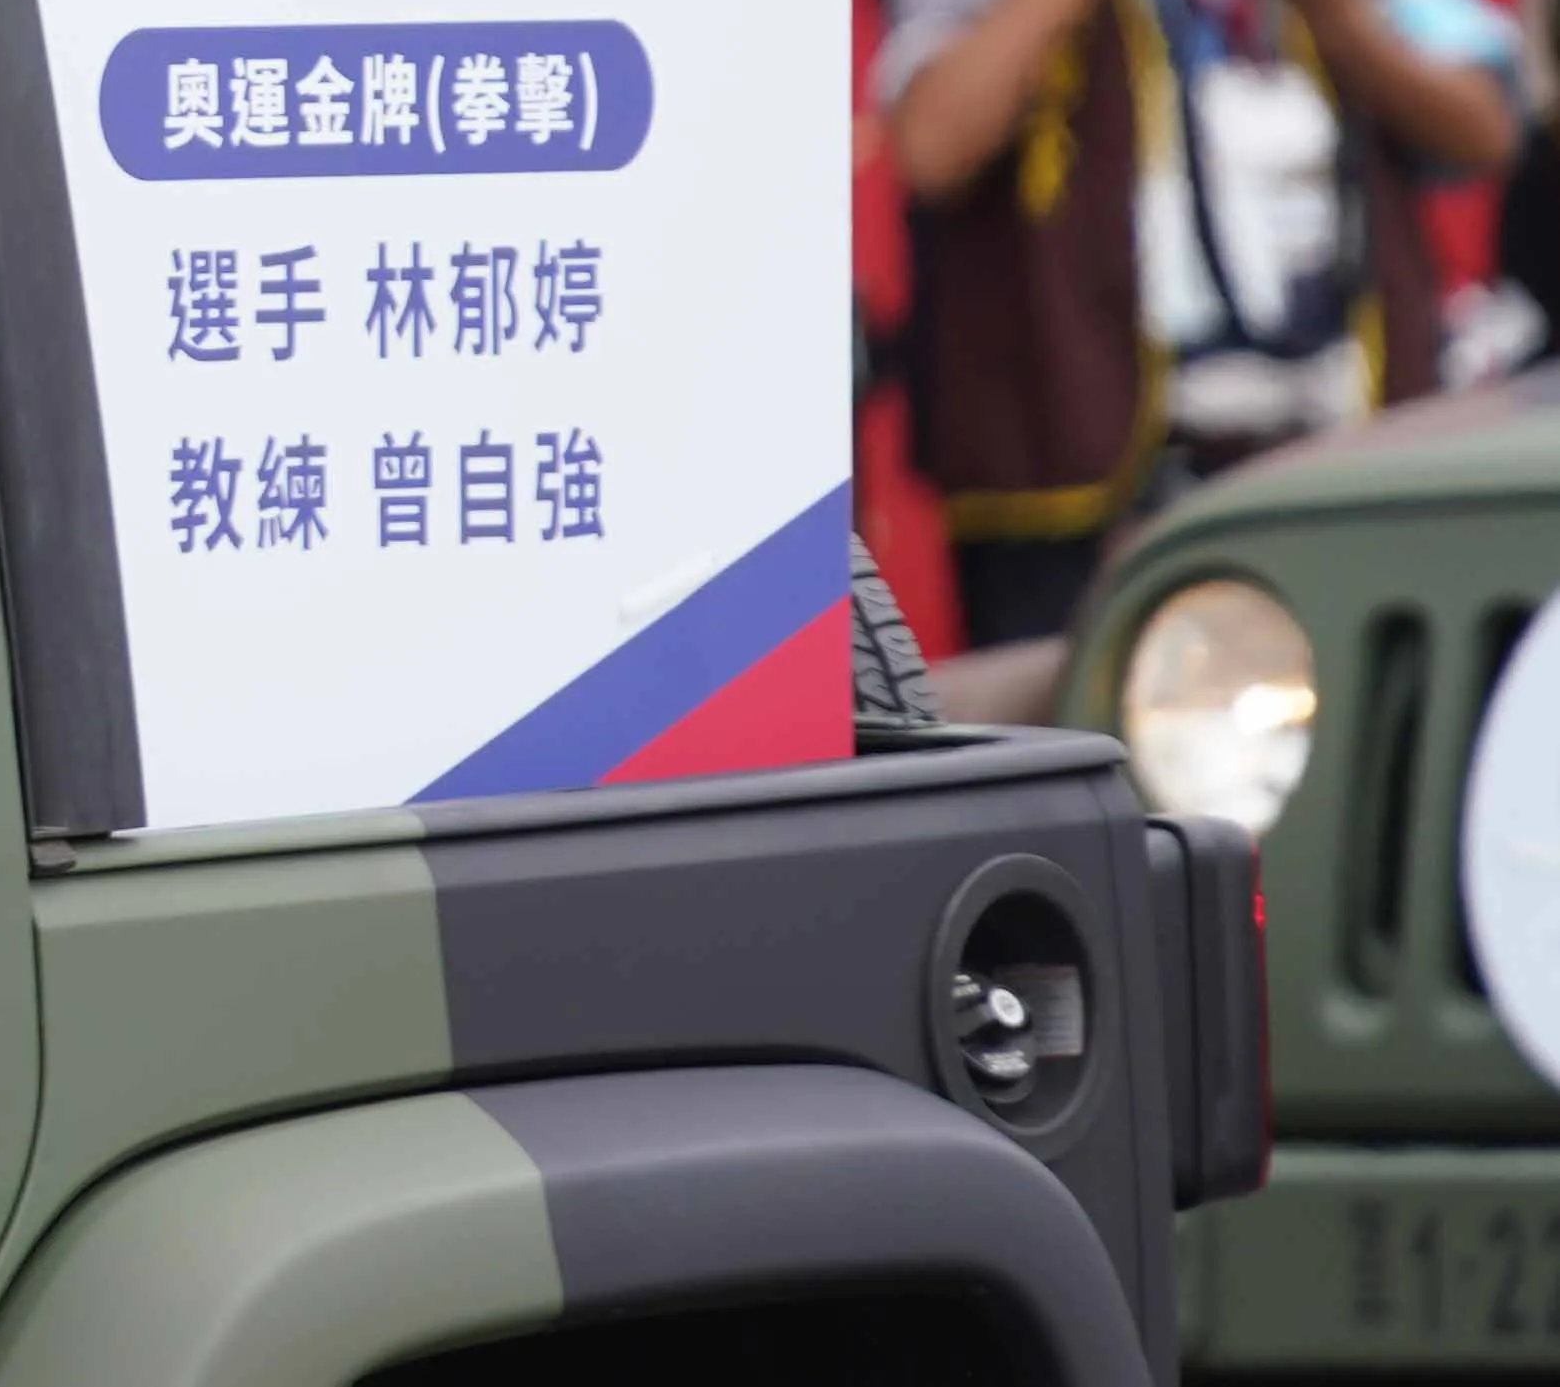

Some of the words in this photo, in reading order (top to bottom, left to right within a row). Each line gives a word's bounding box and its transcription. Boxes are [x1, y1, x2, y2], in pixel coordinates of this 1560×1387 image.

[164, 51, 599, 153] 奧運金牌(拳擊)
[166, 243, 327, 364] 選手
[363, 240, 603, 361] 林郁婷
[168, 435, 327, 553] 教練
[370, 428, 604, 549] 曾自強
